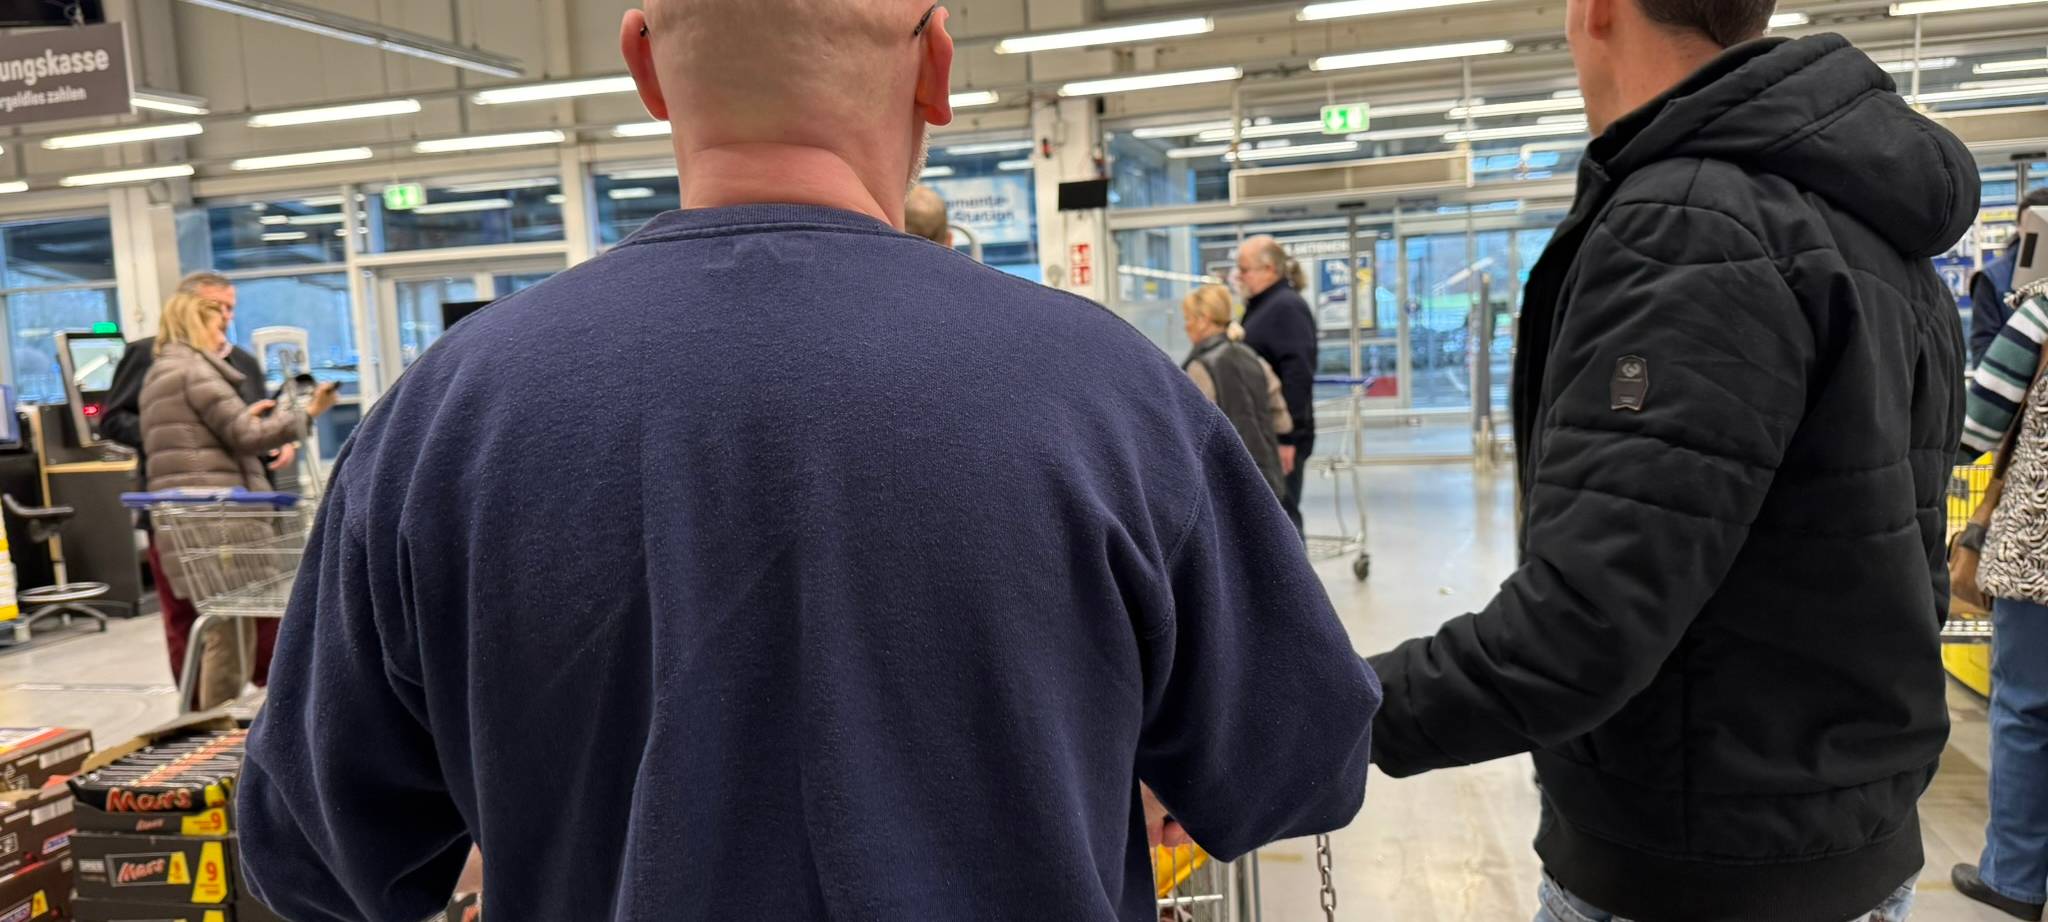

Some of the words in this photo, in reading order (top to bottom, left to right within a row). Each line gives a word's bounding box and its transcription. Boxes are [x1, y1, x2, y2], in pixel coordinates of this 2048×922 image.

[0, 48, 110, 86] ungskasse
[46, 85, 87, 104] zahlen
[106, 786, 193, 813] Mars
[210, 811, 222, 830] 9
[117, 858, 167, 884] Mars
[205, 861, 218, 882] 9
